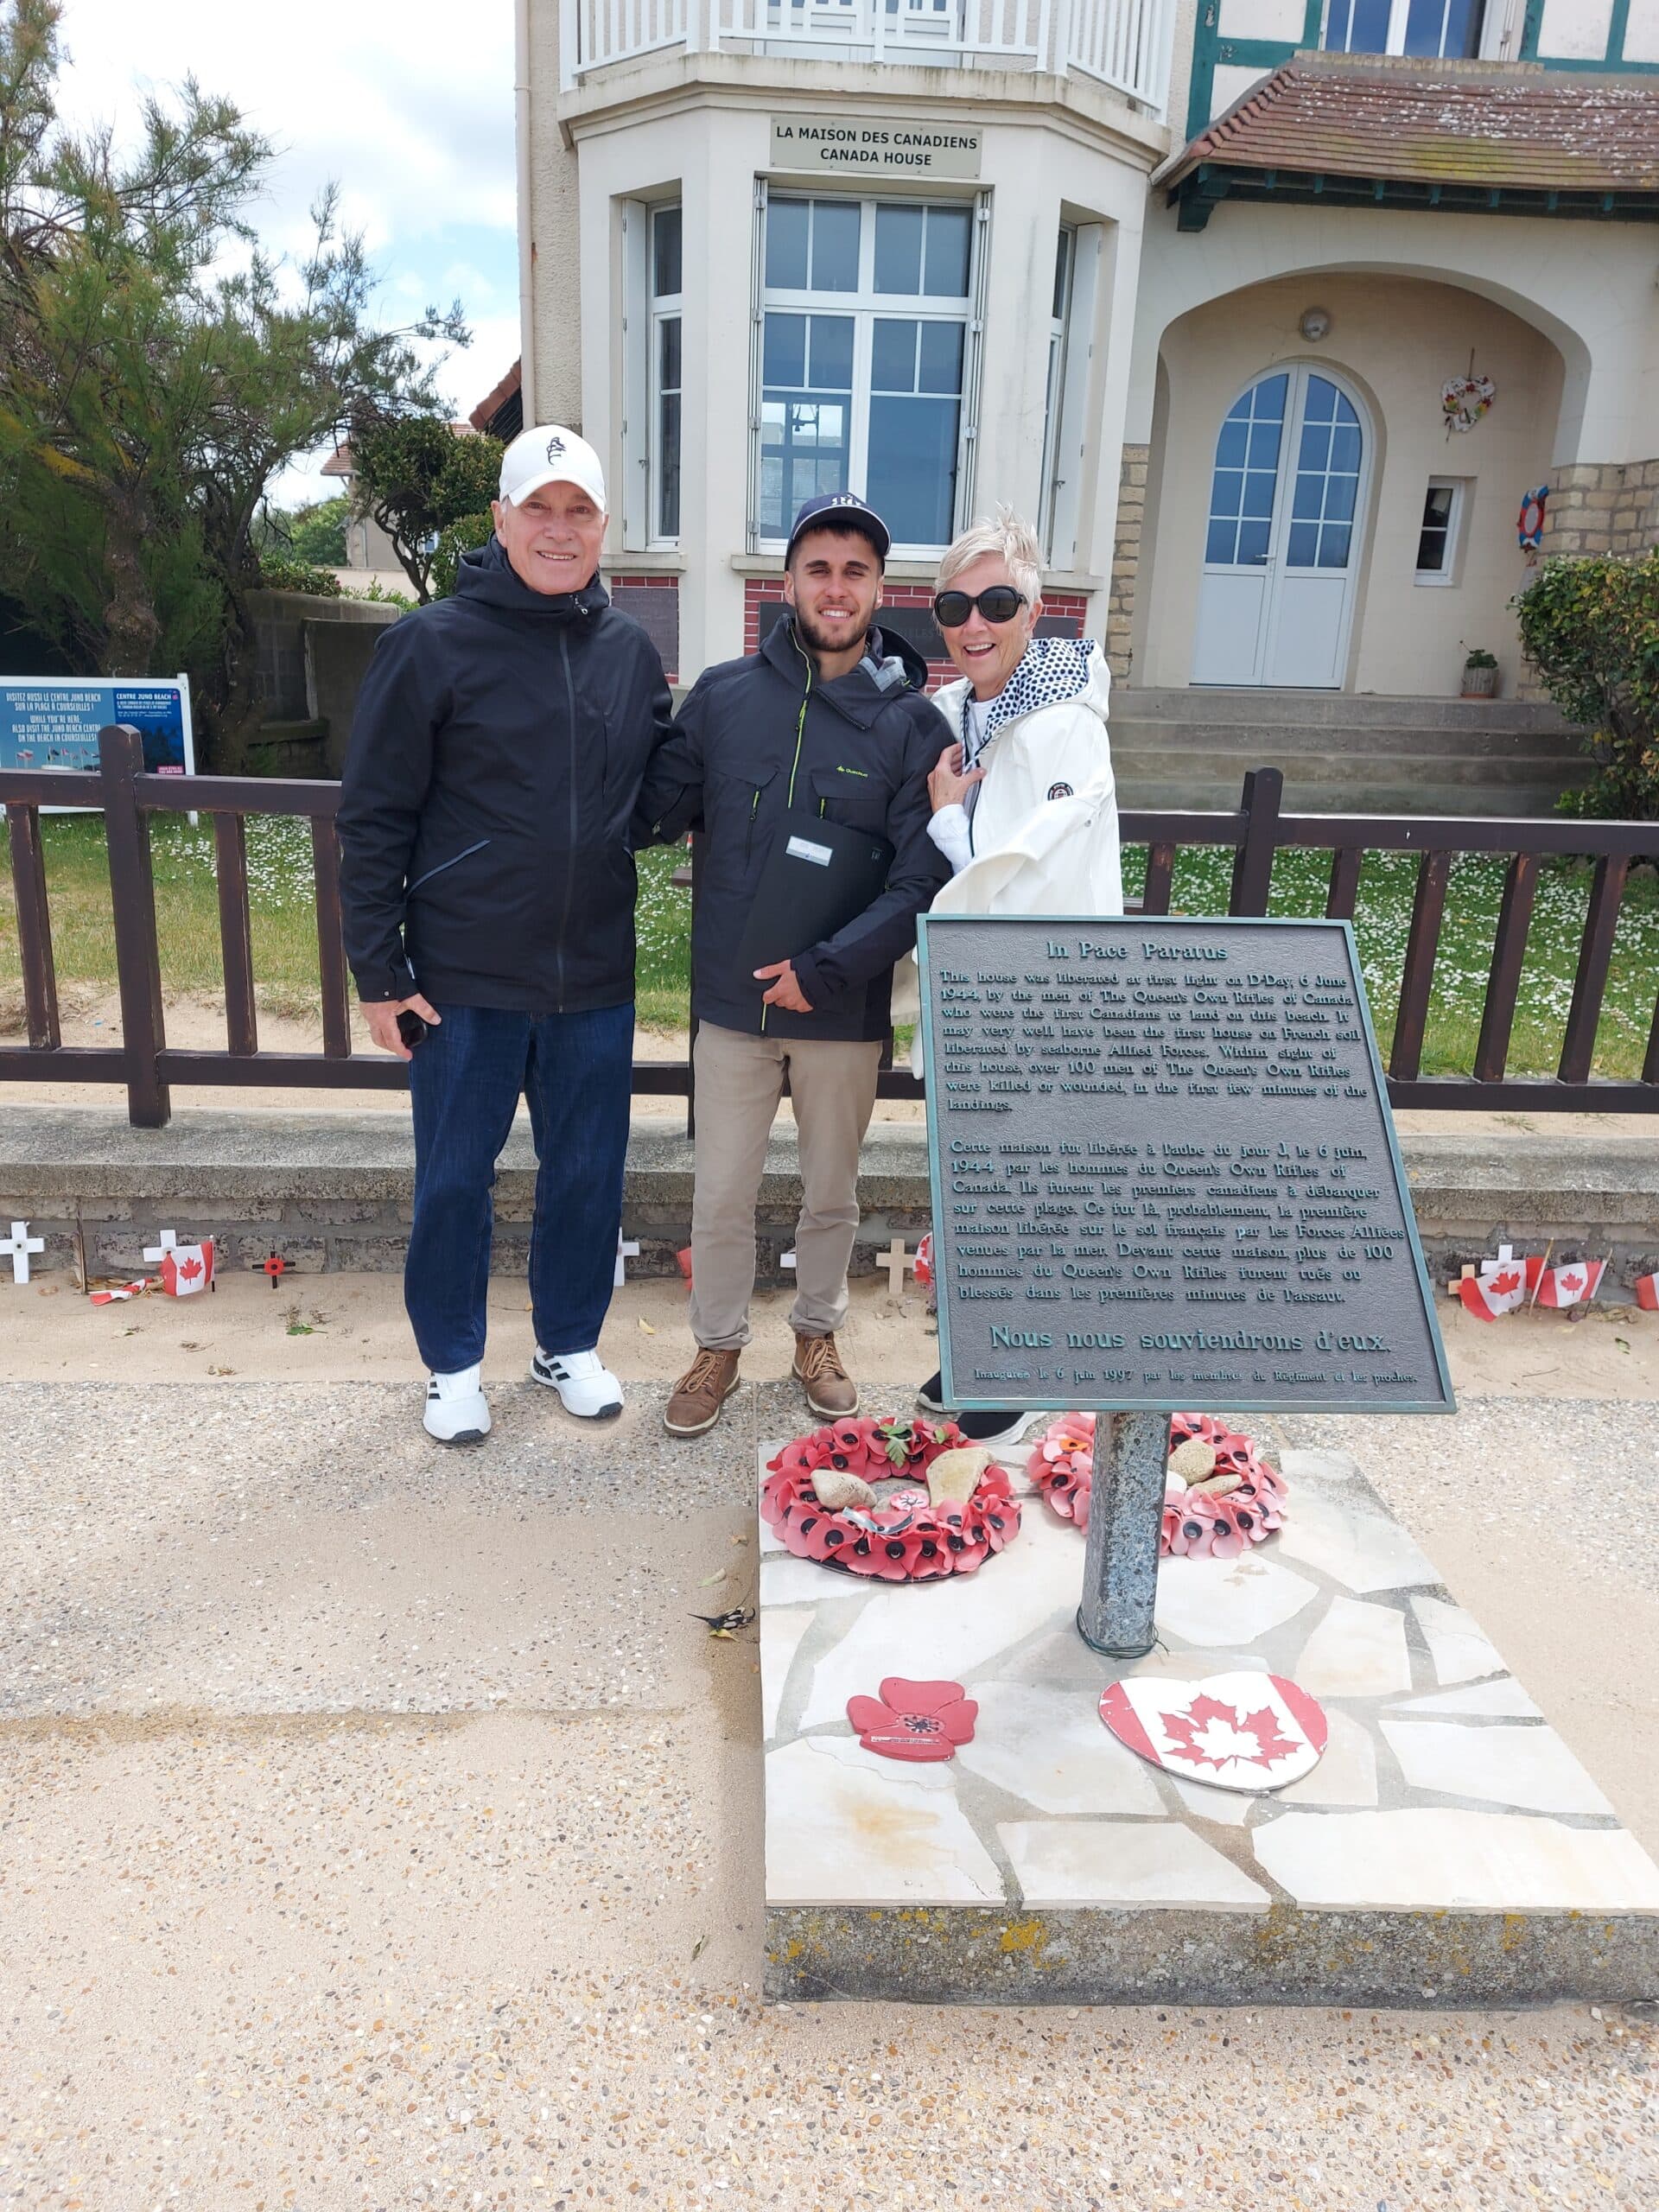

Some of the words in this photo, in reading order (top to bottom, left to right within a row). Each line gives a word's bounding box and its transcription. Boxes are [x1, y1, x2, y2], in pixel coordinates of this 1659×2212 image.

[776, 126, 793, 138] LA
[798, 128, 856, 142] MAISON
[861, 131, 889, 143] DES
[894, 133, 977, 149] CANADIENS
[821, 148, 879, 162] CANADA
[885, 152, 931, 166] HOUSE
[44, 693, 48, 702] LE
[1047, 941, 1069, 959] In
[1080, 941, 1128, 959] Pace
[1142, 943, 1229, 961] Paratus
[940, 969, 970, 984] This
[977, 971, 1018, 984] house
[1025, 973, 1050, 984] was
[1057, 973, 1119, 985] liberated
[1147, 974, 1177, 986] first
[1185, 975, 1217, 988] light
[1226, 977, 1243, 987] on
[1300, 975, 1309, 987] 6
[1315, 976, 1347, 988] June
[986, 989, 1004, 1002] by
[1011, 989, 1033, 1001] the
[1042, 992, 1071, 1002] men
[1100, 991, 1127, 1002] The
[1134, 991, 1188, 1005] Queen's
[1194, 993, 1229, 1004] Own
[1233, 993, 1274, 1005] Rifles
[1302, 994, 1354, 1006] Canada
[942, 1007, 972, 1018] who
[980, 1008, 1015, 1019] were
[1022, 1007, 1045, 1019] the
[1053, 1007, 1084, 1020] first
[1090, 1007, 1160, 1020] Canadians
[1190, 1010, 1219, 1021] land
[1227, 1012, 1243, 1021] on
[1251, 1011, 1277, 1021] this
[943, 1026, 973, 1039] may
[982, 1026, 1014, 1039] very
[1023, 1026, 1055, 1037] well
[1062, 1026, 1095, 1038] have
[1103, 1026, 1137, 1039] been
[1143, 1026, 1165, 1039] the
[1174, 1027, 1206, 1039] first
[1212, 1027, 1252, 1039] house
[1260, 1029, 1276, 1039] on
[1282, 1027, 1331, 1040] French
[1337, 1029, 1361, 1040] soil
[944, 1043, 1007, 1055] liberated
[1015, 1043, 1034, 1056] by
[1041, 1044, 1102, 1056] seaborne
[1109, 1044, 1153, 1057] Allied
[1219, 1046, 1268, 1058] Within
[1279, 1047, 1313, 1060] sight
[944, 1061, 972, 1073] this
[1029, 1065, 1060, 1074] over
[1069, 1062, 1096, 1074] 100
[1103, 1065, 1134, 1074] men
[1166, 1063, 1194, 1075] The
[1204, 1064, 1257, 1077] Queen's
[1267, 1065, 1301, 1077] Own
[1308, 1065, 1351, 1077] Rifles
[946, 1082, 982, 1091] were
[988, 1080, 1032, 1092] killed
[1155, 1083, 1179, 1094] the
[1188, 1083, 1218, 1095] first
[1227, 1084, 1252, 1095] few
[1262, 1084, 1318, 1096] minutes
[1344, 1084, 1369, 1096] the
[950, 1140, 992, 1154] Cette
[1000, 1141, 1051, 1154] maison
[1059, 1141, 1081, 1154] fut
[1088, 1142, 1138, 1154] libérée
[1163, 1143, 1205, 1156] l'aube
[1214, 1144, 1231, 1156] du
[1240, 1145, 1270, 1158] jour
[951, 1160, 995, 1174] 1944
[1006, 1164, 1030, 1177] par
[1039, 1162, 1060, 1174] les
[1069, 1162, 1129, 1174] hommes
[1138, 1162, 1157, 1175] du
[1163, 1163, 1222, 1177] Queen's
[1230, 1164, 1267, 1177] Own
[1275, 1164, 1320, 1177] Rifles
[1331, 1166, 1347, 1178] of
[1020, 1181, 1039, 1194] Ils
[1048, 1182, 1094, 1194] furent
[1102, 1183, 1122, 1195] les
[1133, 1185, 1196, 1198] premiers
[1207, 1185, 1279, 1198] canadiens
[1306, 1185, 1380, 1200] débarquer
[953, 1202, 977, 1214] sur
[987, 1203, 1026, 1214] cette
[1084, 1201, 1106, 1214] Ce
[1112, 1203, 1135, 1215] fut
[1278, 1205, 1294, 1217] la
[1300, 1205, 1369, 1221] première
[955, 1222, 1009, 1235] maison
[1017, 1222, 1070, 1235] libérée
[1080, 1224, 1104, 1236] sur
[1112, 1223, 1128, 1236] le
[1136, 1224, 1158, 1236] sol
[1166, 1225, 1226, 1242] français
[1236, 1227, 1260, 1240] par
[1270, 1225, 1289, 1237] les
[1296, 1225, 1347, 1238] Forces
[1351, 1225, 1405, 1239] Alliées
[957, 1244, 1009, 1256] venues
[1018, 1245, 1042, 1259] par
[1051, 1243, 1066, 1256] la
[1117, 1243, 1174, 1258] Devant
[1183, 1247, 1222, 1258] cette
[1296, 1245, 1327, 1262] plus
[1338, 1246, 1357, 1258] de
[1364, 1246, 1395, 1259] 100
[957, 1265, 1023, 1278] hommes
[1033, 1264, 1053, 1277] du
[1063, 1264, 1123, 1279] Queen's
[1133, 1265, 1172, 1279] Own
[1183, 1266, 1227, 1280] Rifles
[1239, 1267, 1287, 1280] furent
[1300, 1267, 1332, 1280] tués
[1342, 1270, 1362, 1280] ou
[958, 1287, 1014, 1300] blessés
[1026, 1286, 1061, 1300] dans
[1071, 1287, 1092, 1300] les
[1097, 1287, 1174, 1303] premières
[1185, 1288, 1247, 1301] minutes
[1257, 1288, 1275, 1301] de
[989, 1325, 1053, 1348] Nous
[1066, 1332, 1125, 1348] nous
[1141, 1328, 1303, 1351] souviendrons
[1073, 1370, 1096, 1384] juin
[1103, 1370, 1134, 1381] 1997
